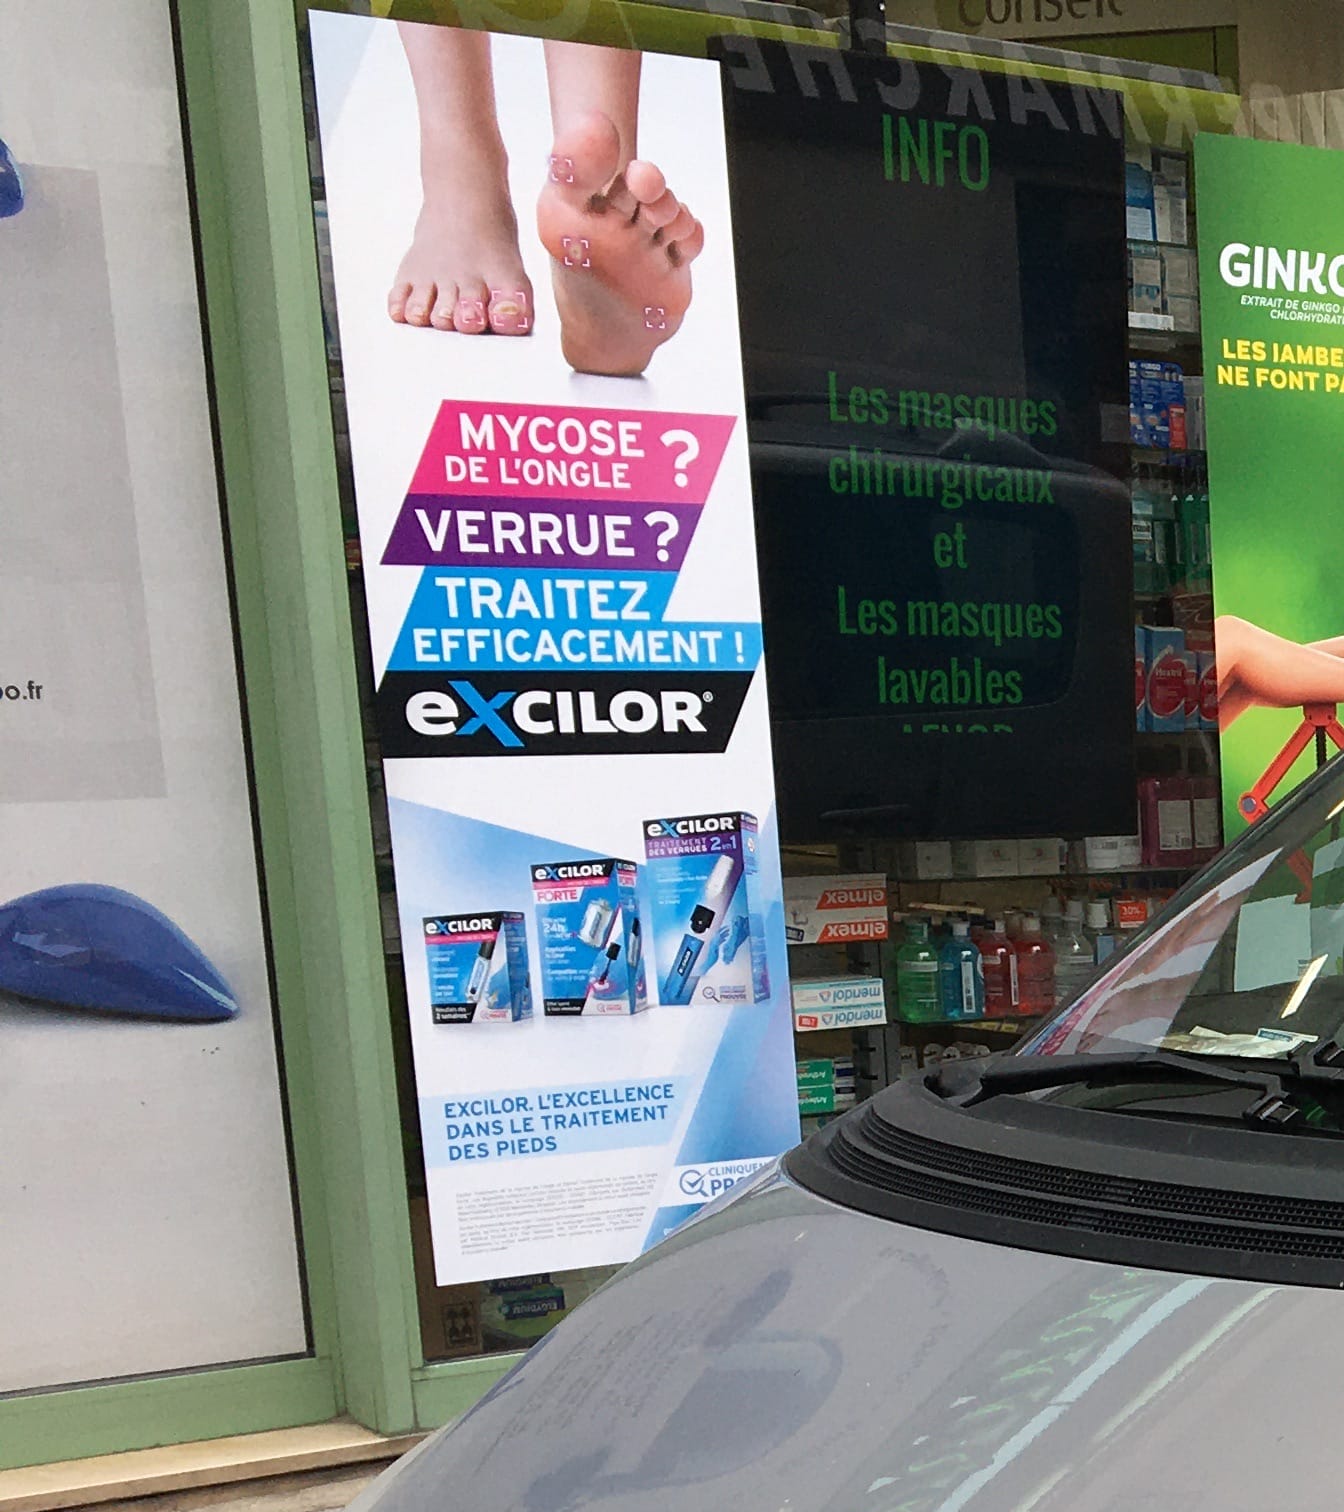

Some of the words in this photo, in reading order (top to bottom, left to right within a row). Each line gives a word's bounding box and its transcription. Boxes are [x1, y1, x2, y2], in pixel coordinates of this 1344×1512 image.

[882, 113, 990, 192] INFO
[1240, 294, 1284, 309] EXTRAIT
[1285, 299, 1299, 311] DE
[1301, 301, 1340, 314] GINKGO
[1222, 338, 1267, 362] LES
[1217, 364, 1249, 387] NE
[1255, 368, 1320, 392] FONT
[827, 370, 890, 425] Les
[899, 388, 1058, 442] masques
[458, 411, 645, 457] MYCOSE
[659, 428, 700, 488] ?
[443, 454, 489, 484] DE
[498, 456, 631, 489] L'ONGLE
[828, 445, 1055, 509] chirurgicaux
[932, 521, 969, 569] et
[434, 576, 650, 622] TRAITEZ
[837, 585, 898, 636] Les
[907, 599, 1063, 646] masques
[412, 627, 722, 665] EFFICACEMENT
[877, 655, 1024, 705] lavables
[825, 889, 885, 907] elmex
[826, 921, 886, 939] elmex
[444, 1096, 534, 1119] EXCILOR.
[537, 1083, 674, 1111] L'EXCELLENCE
[446, 1119, 504, 1141] DANS
[510, 1117, 534, 1134] LE
[540, 1104, 669, 1131] TRAITEMENT
[449, 1145, 490, 1161] DES
[496, 1136, 558, 1157] PIEDS
